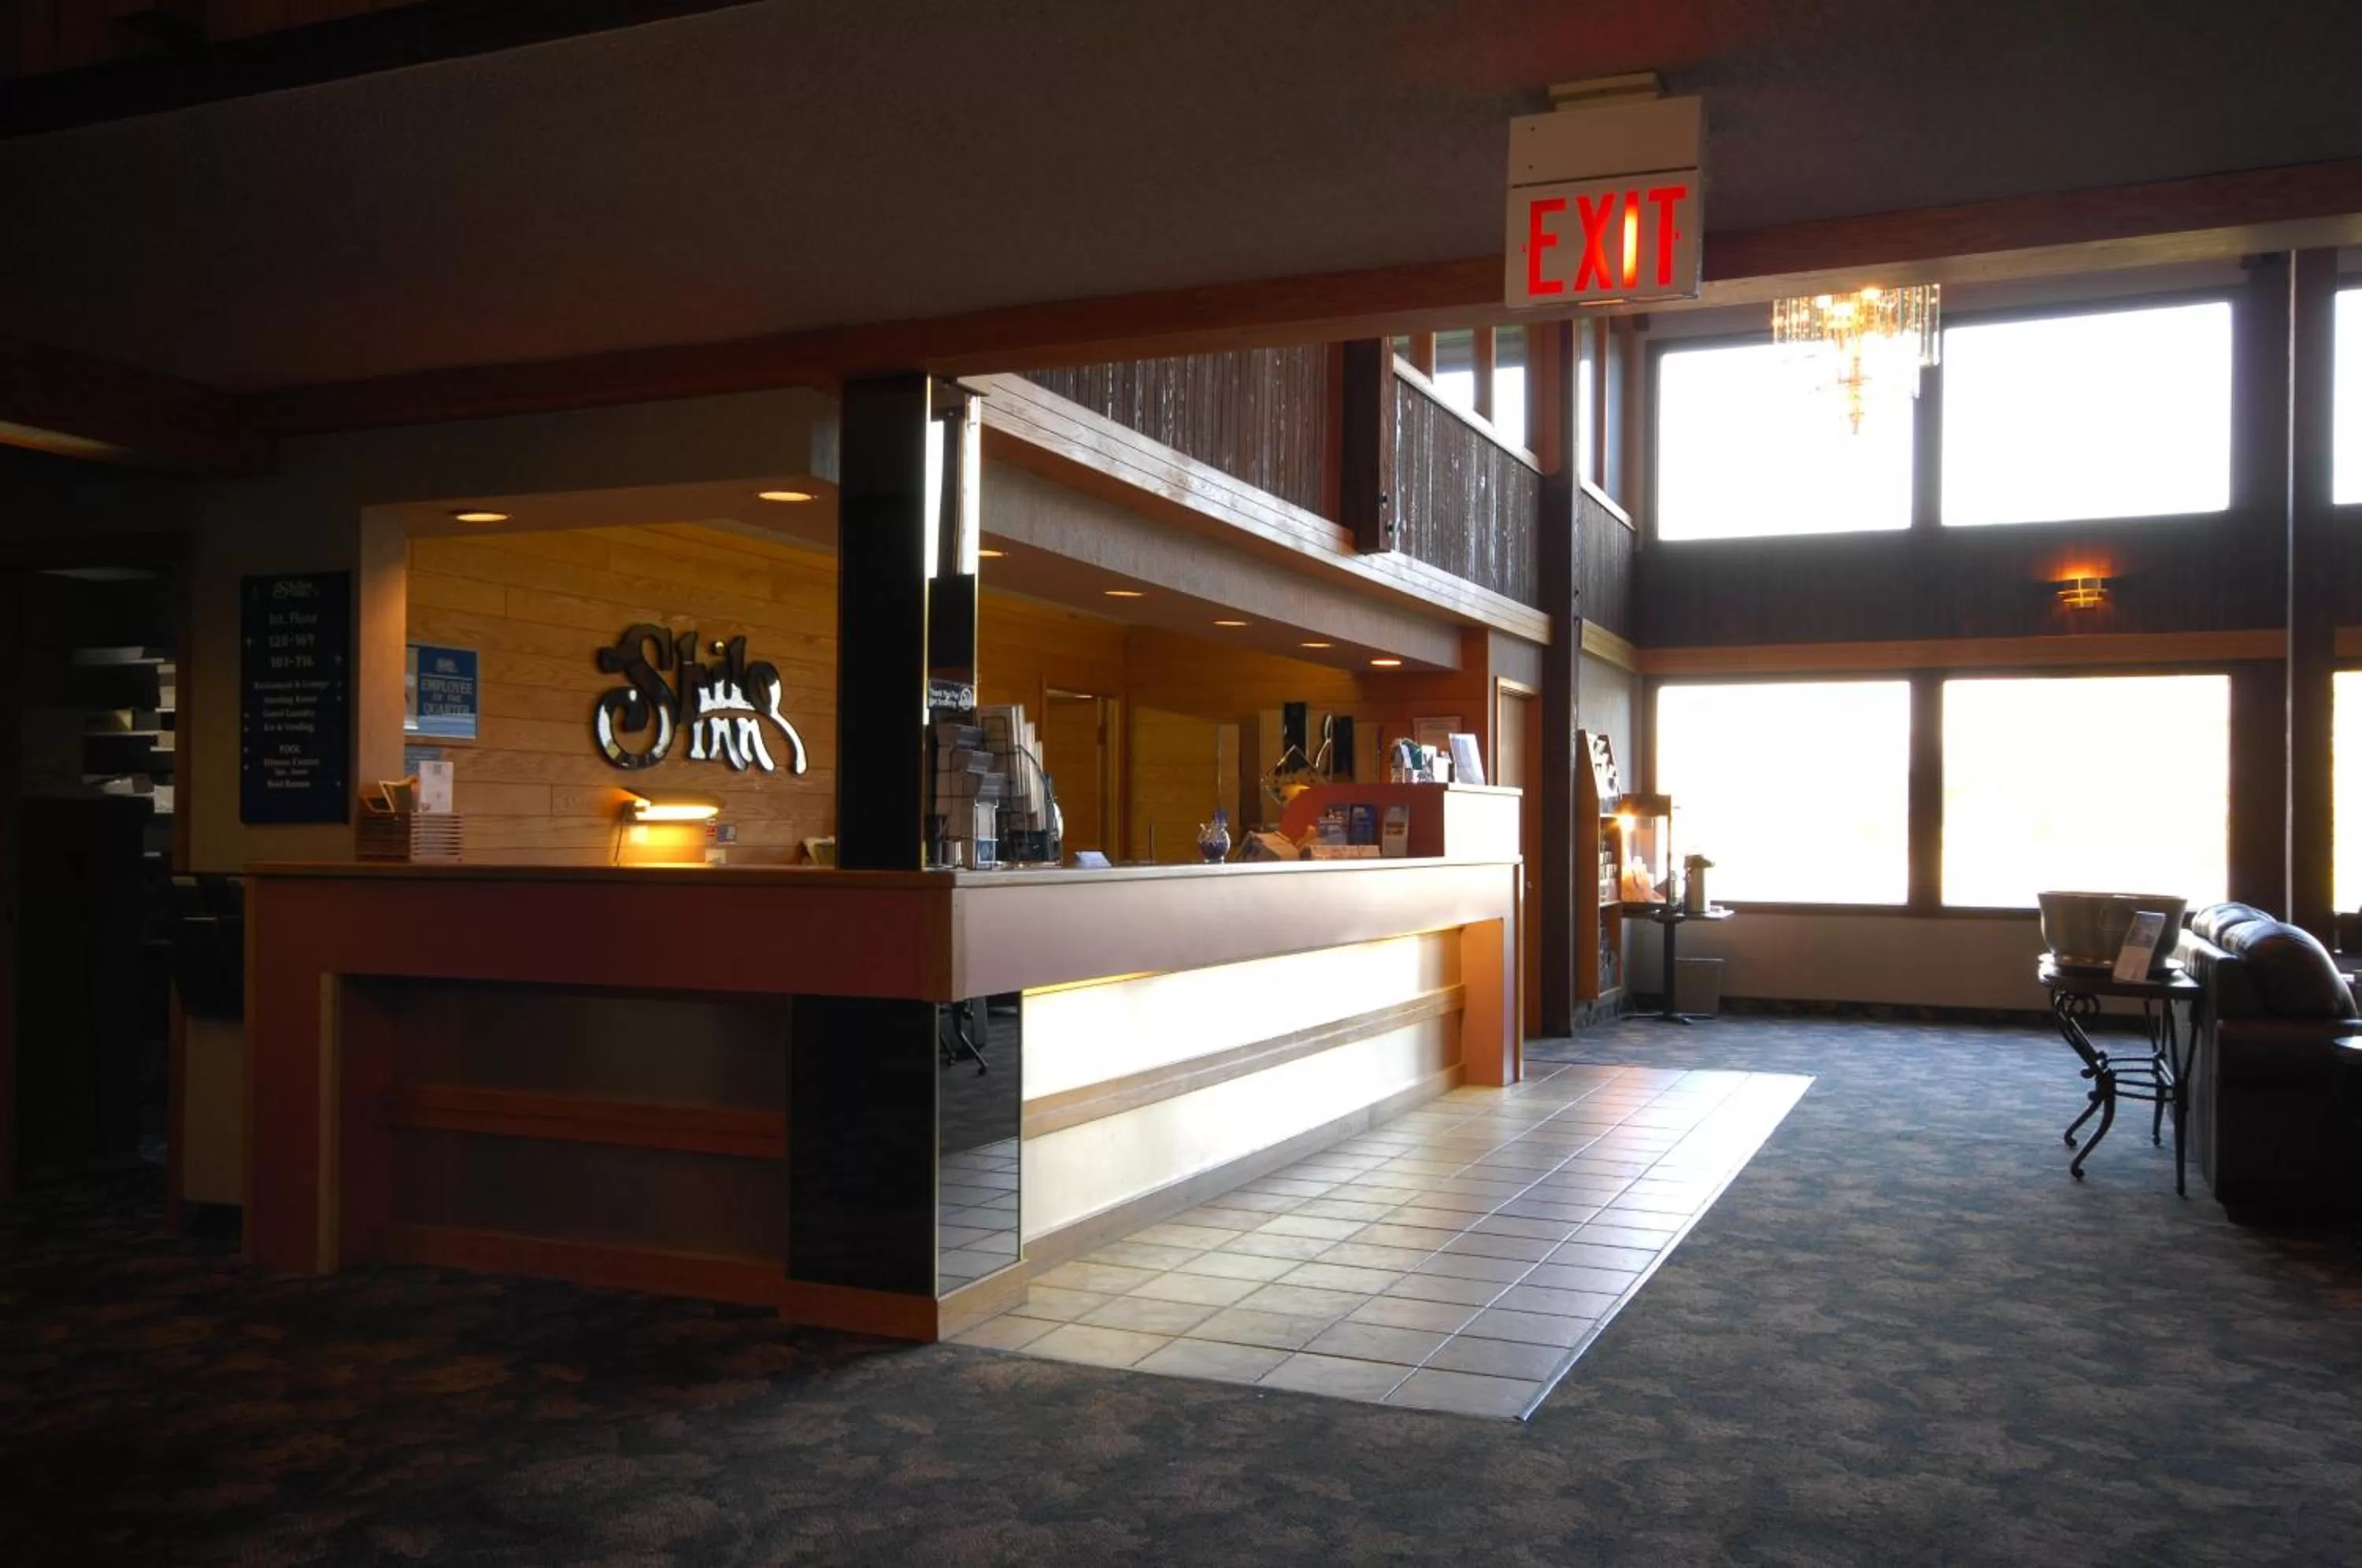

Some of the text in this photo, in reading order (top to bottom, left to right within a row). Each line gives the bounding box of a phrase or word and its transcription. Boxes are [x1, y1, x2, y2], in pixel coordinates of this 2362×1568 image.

[1528, 187, 1688, 295] EXIT
[421, 679, 473, 693] EMPLOYEE
[423, 703, 470, 716] QUARTER
[594, 624, 807, 775] Shilo
